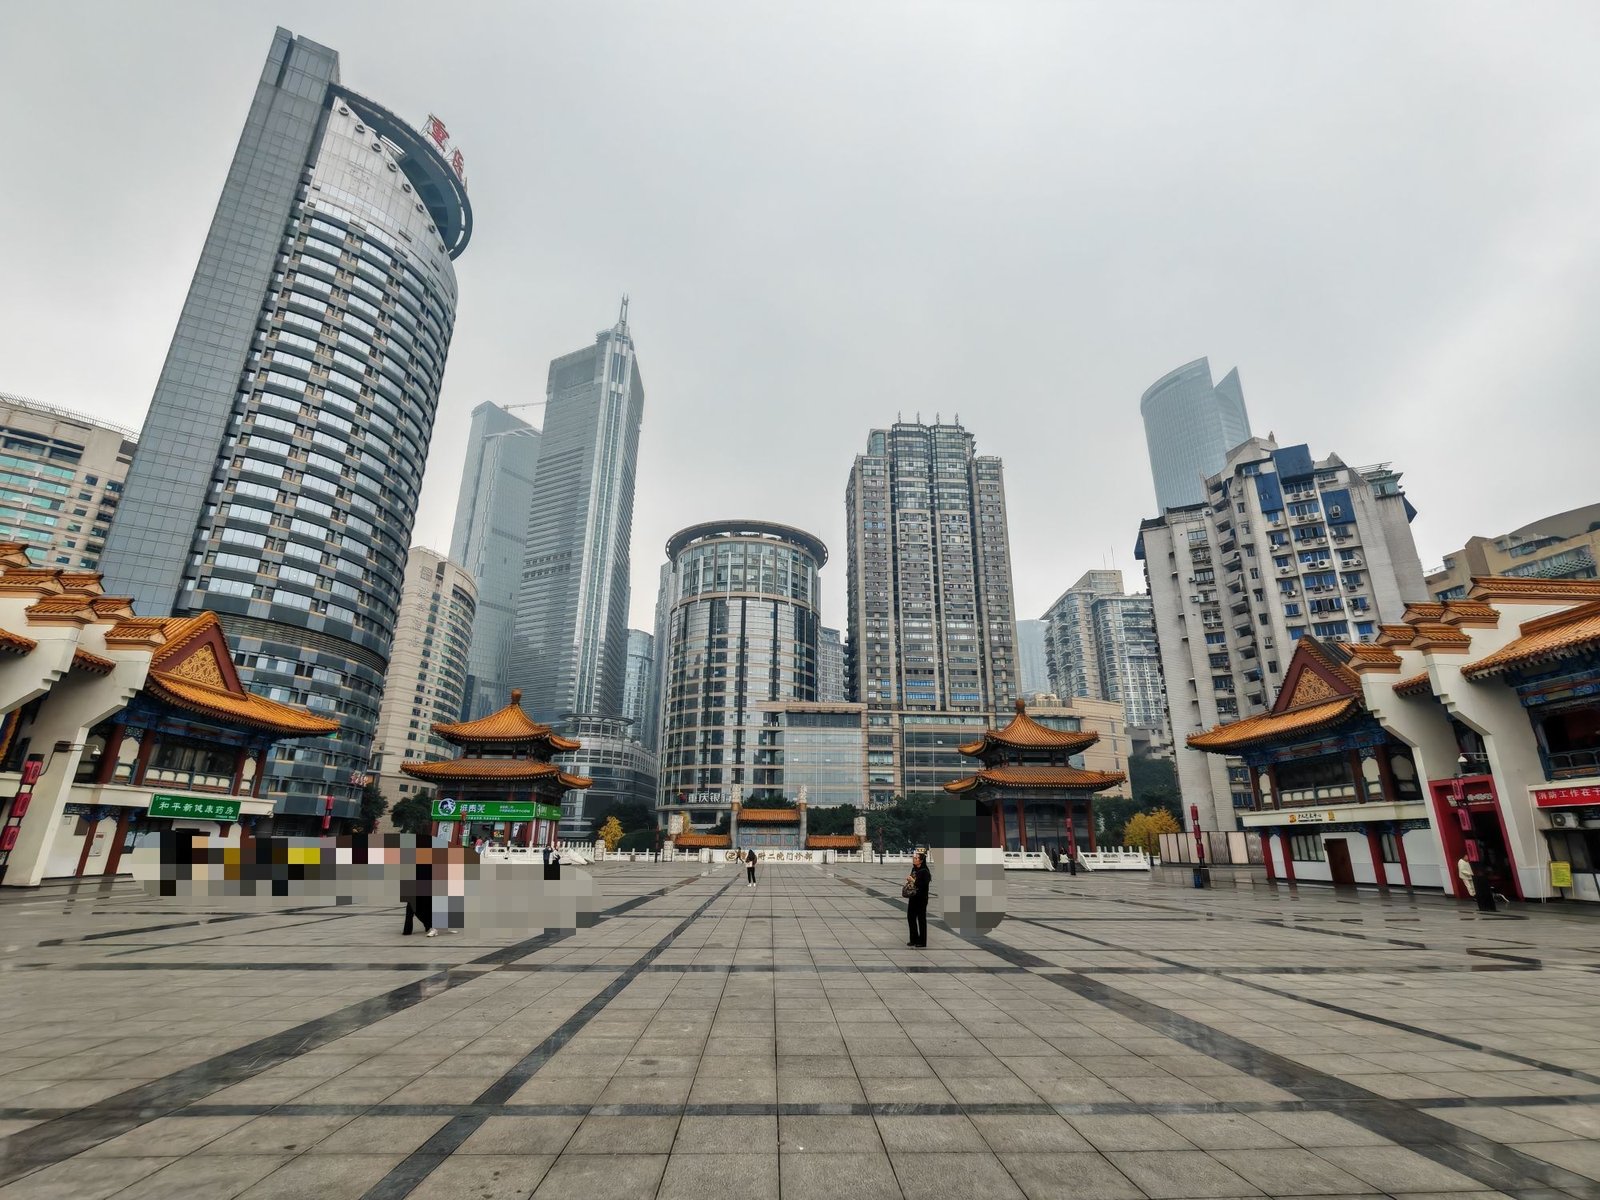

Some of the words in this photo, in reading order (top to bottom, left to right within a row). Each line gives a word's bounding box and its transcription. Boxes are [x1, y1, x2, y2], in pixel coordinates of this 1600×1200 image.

[688, 792, 732, 803] 重庆银行
[158, 801, 234, 815] 和平新健康药房
